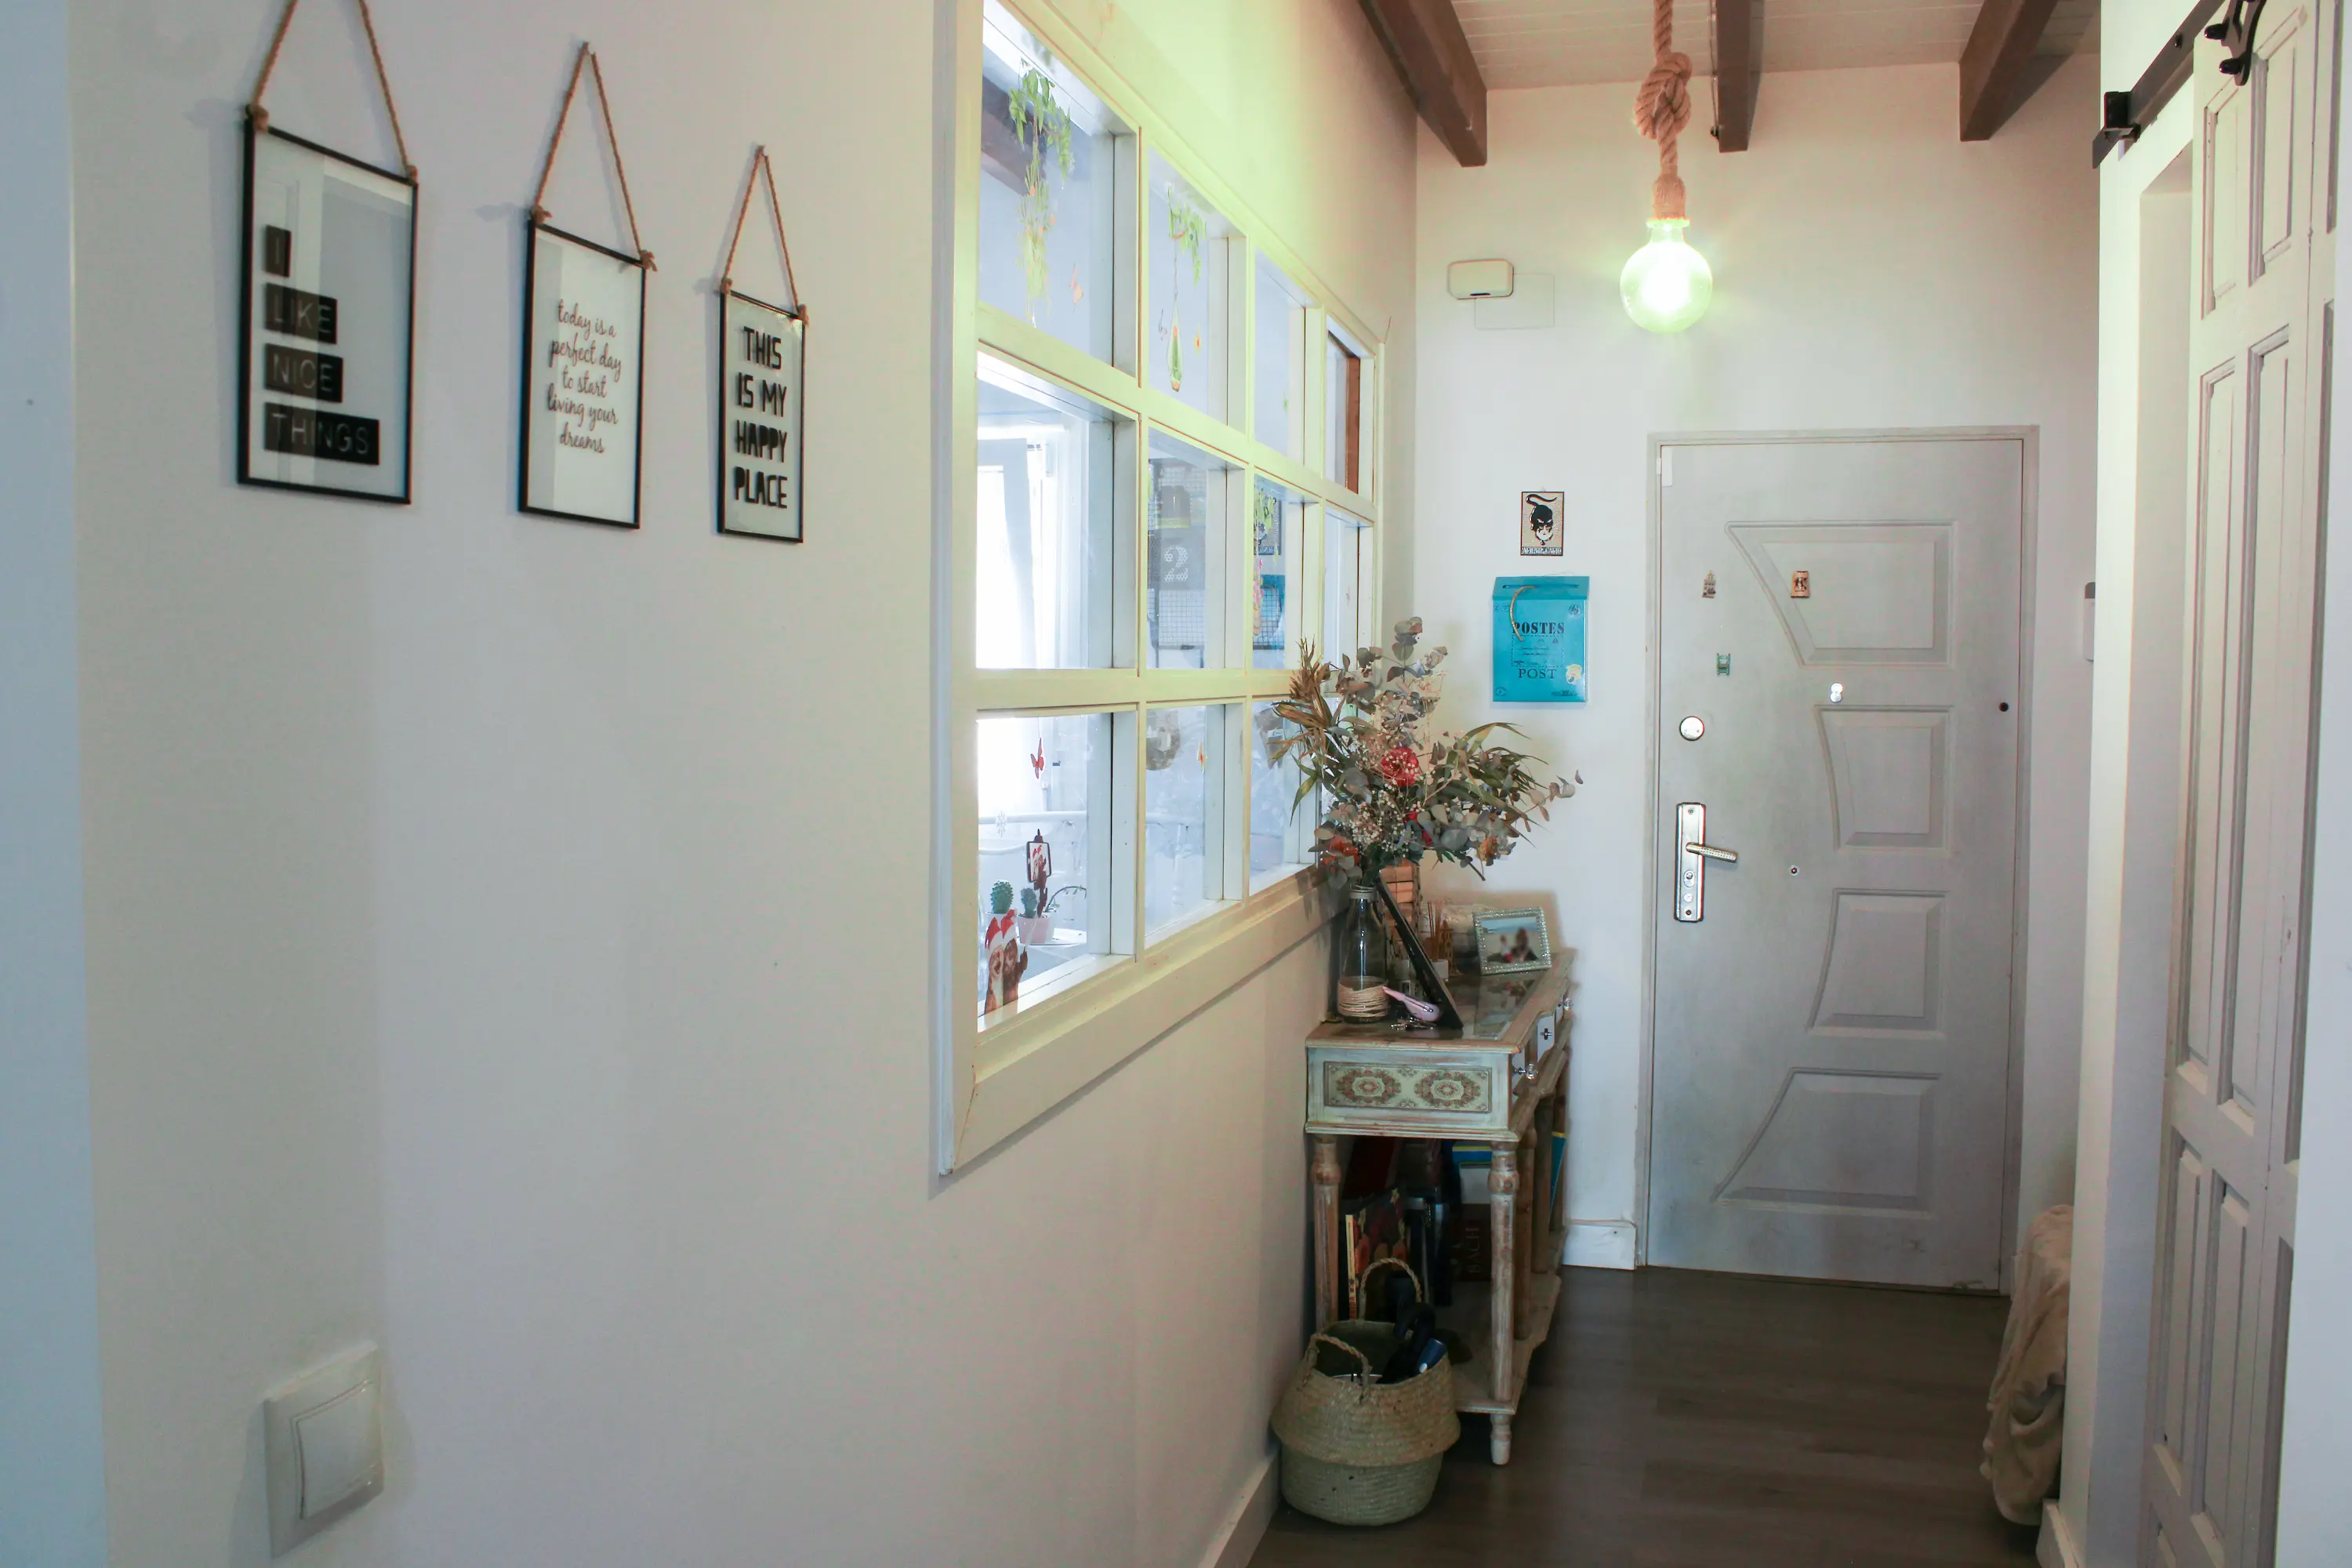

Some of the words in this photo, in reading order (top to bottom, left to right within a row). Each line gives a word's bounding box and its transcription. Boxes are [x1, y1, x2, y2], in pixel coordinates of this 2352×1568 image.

[274, 293, 332, 334] LIKE
[557, 298, 591, 341] today
[594, 318, 607, 336] is
[608, 325, 616, 338] a
[549, 332, 597, 368] perfect
[599, 342, 622, 383] day
[743, 325, 782, 370] THIS
[273, 354, 333, 392] NICE
[562, 365, 574, 390] to
[577, 370, 608, 398] start
[548, 382, 586, 428] living
[589, 405, 619, 432] your
[737, 372, 754, 408] IS
[762, 379, 787, 418] MY
[271, 411, 370, 456] THINGS
[559, 421, 605, 454] dreams
[736, 419, 788, 463] HAPPY
[734, 466, 788, 509] PLACE
[1163, 545, 1189, 582] 2
[1512, 622, 1565, 634] POSTES
[1518, 668, 1557, 679] POST
